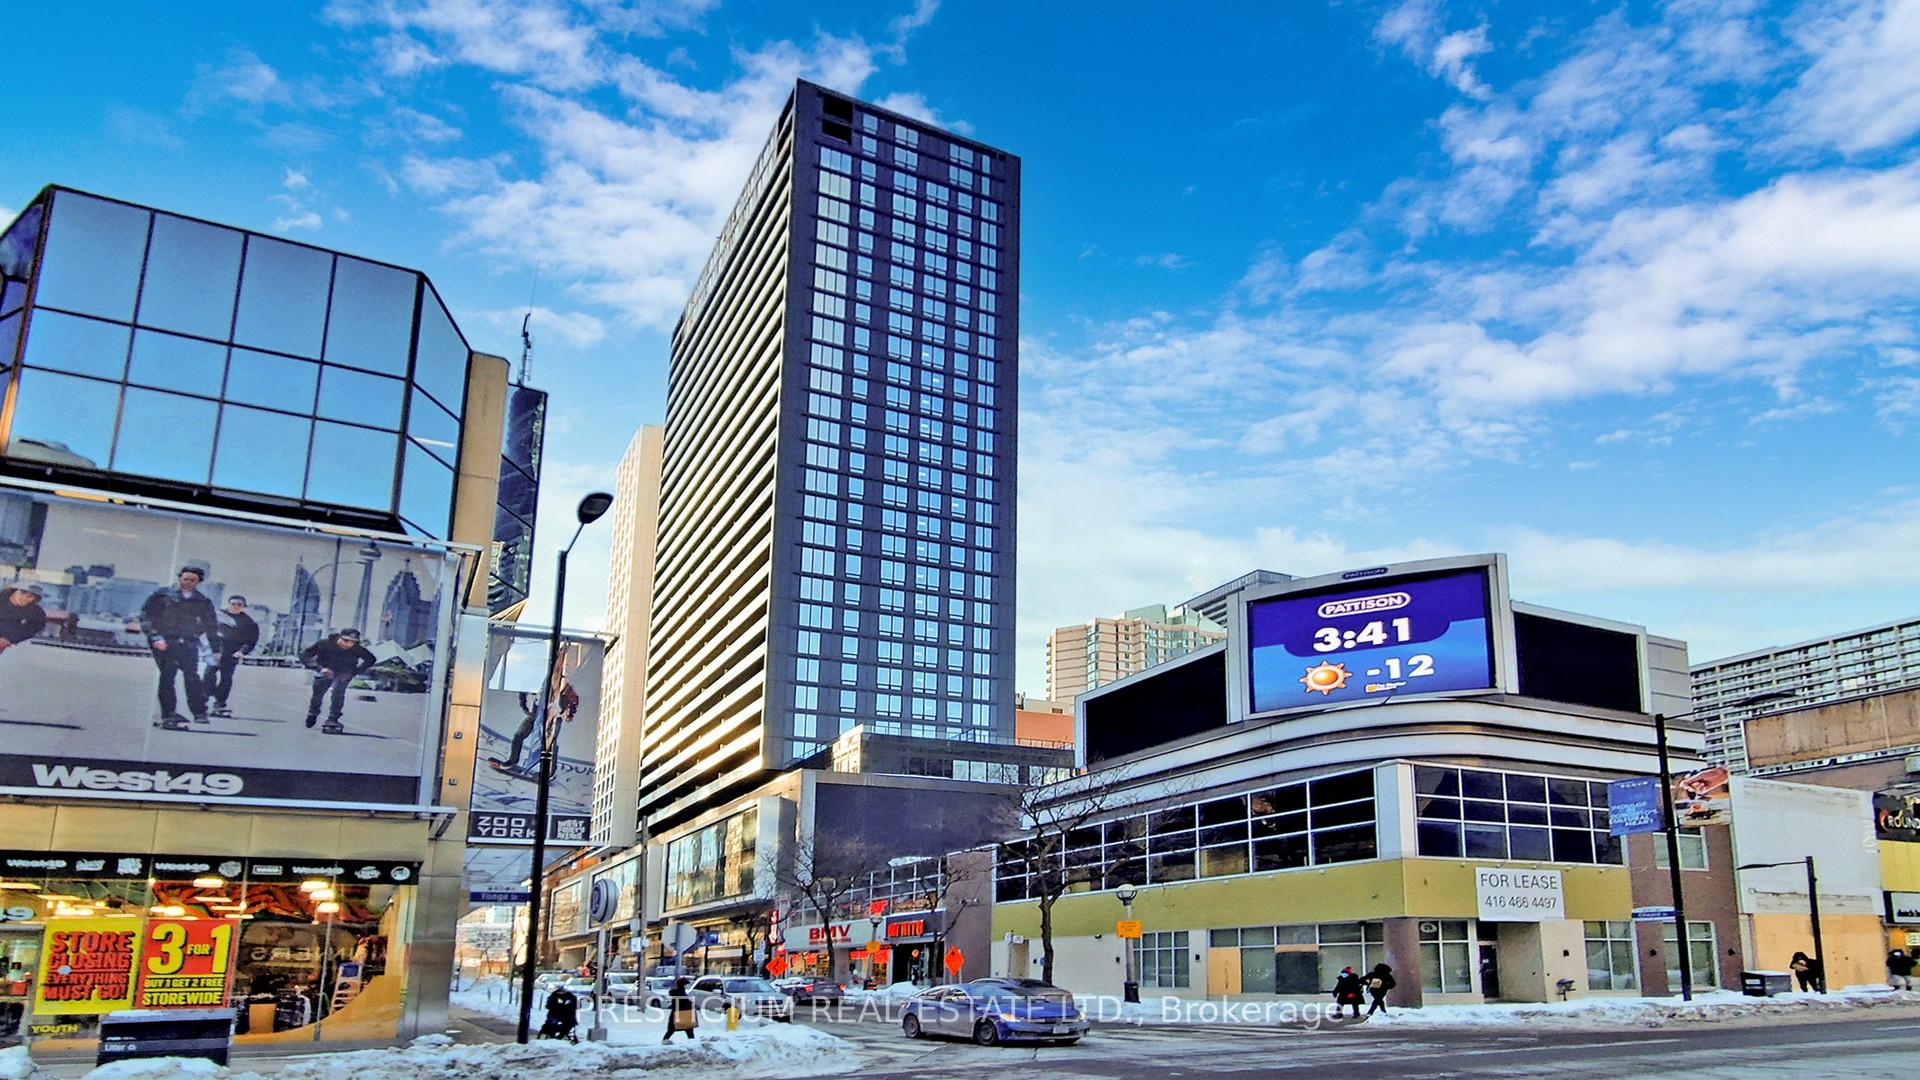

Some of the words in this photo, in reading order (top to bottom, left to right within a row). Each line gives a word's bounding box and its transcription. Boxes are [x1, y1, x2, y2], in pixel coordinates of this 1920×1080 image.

[1325, 595, 1403, 615] PATTISON
[1313, 617, 1411, 652] 3:41
[1366, 654, 1435, 680] -12
[32, 763, 244, 795] West49
[478, 816, 526, 828] ZOO
[477, 826, 536, 838] YORK
[1480, 873, 1510, 888] FOR
[1513, 874, 1558, 890] LEASE
[1485, 895, 1506, 908] 416
[1531, 897, 1557, 909] 4497
[809, 924, 851, 940] BMV
[52, 931, 135, 954] STORE
[147, 923, 187, 975] 3
[187, 943, 211, 956] FOR
[210, 924, 232, 974] 1
[49, 952, 132, 970] CLOSING
[45, 973, 129, 986] EVERYTHING
[144, 978, 164, 988] BUY
[171, 978, 190, 988] GET
[191, 978, 199, 988] 2
[200, 978, 224, 988] FREE
[42, 985, 96, 1001] MUST
[98, 984, 127, 1000] GO!
[142, 990, 222, 1006] STOREWIDE
[31, 1024, 80, 1034] YOUTH
